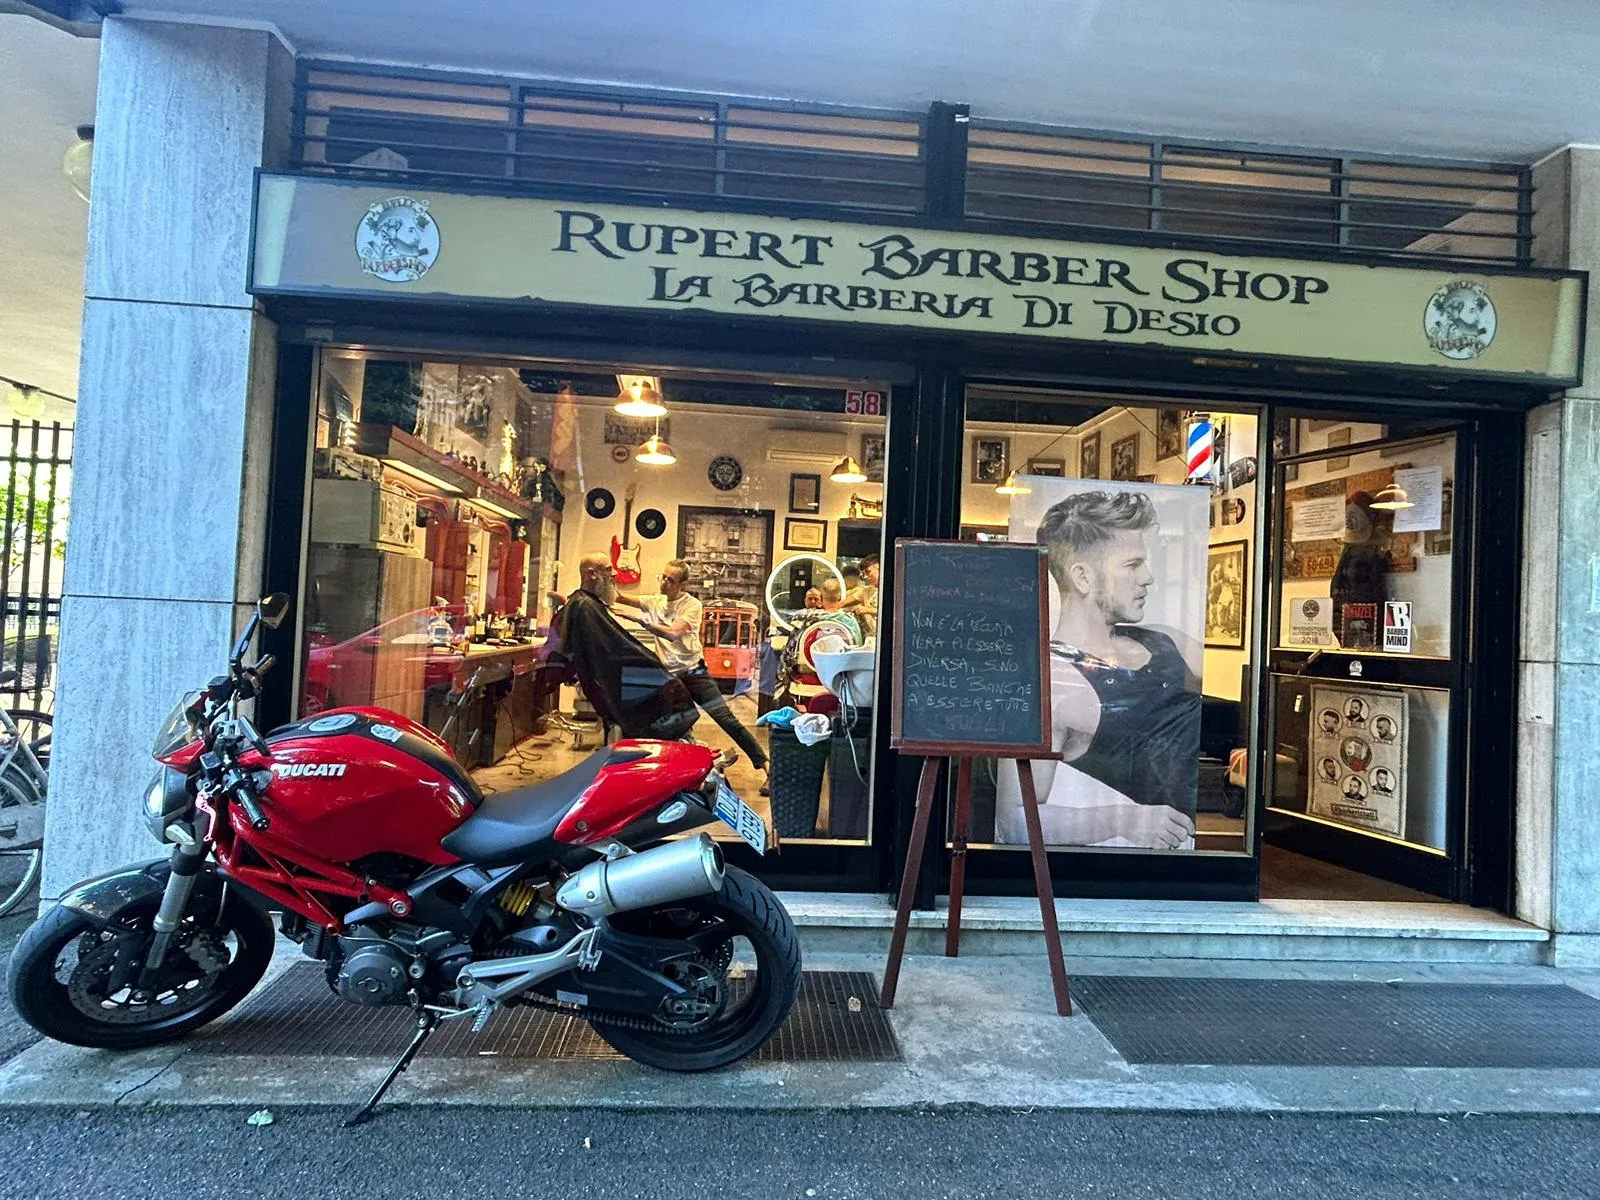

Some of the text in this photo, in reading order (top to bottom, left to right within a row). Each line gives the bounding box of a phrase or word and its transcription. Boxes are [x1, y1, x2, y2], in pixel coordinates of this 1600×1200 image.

[552, 210, 1329, 304] RUPERT BARBER SHOP
[647, 266, 1240, 336] LA BARBERIA DI DESIO
[845, 390, 881, 416] 58
[912, 608, 935, 629] NON
[1386, 636, 1408, 646] MIND
[1387, 628, 1408, 636] BARBER
[907, 673, 958, 689] QUELLE
[907, 693, 918, 708] A
[927, 695, 993, 712] ESSERE
[279, 763, 347, 777] DUCATI
